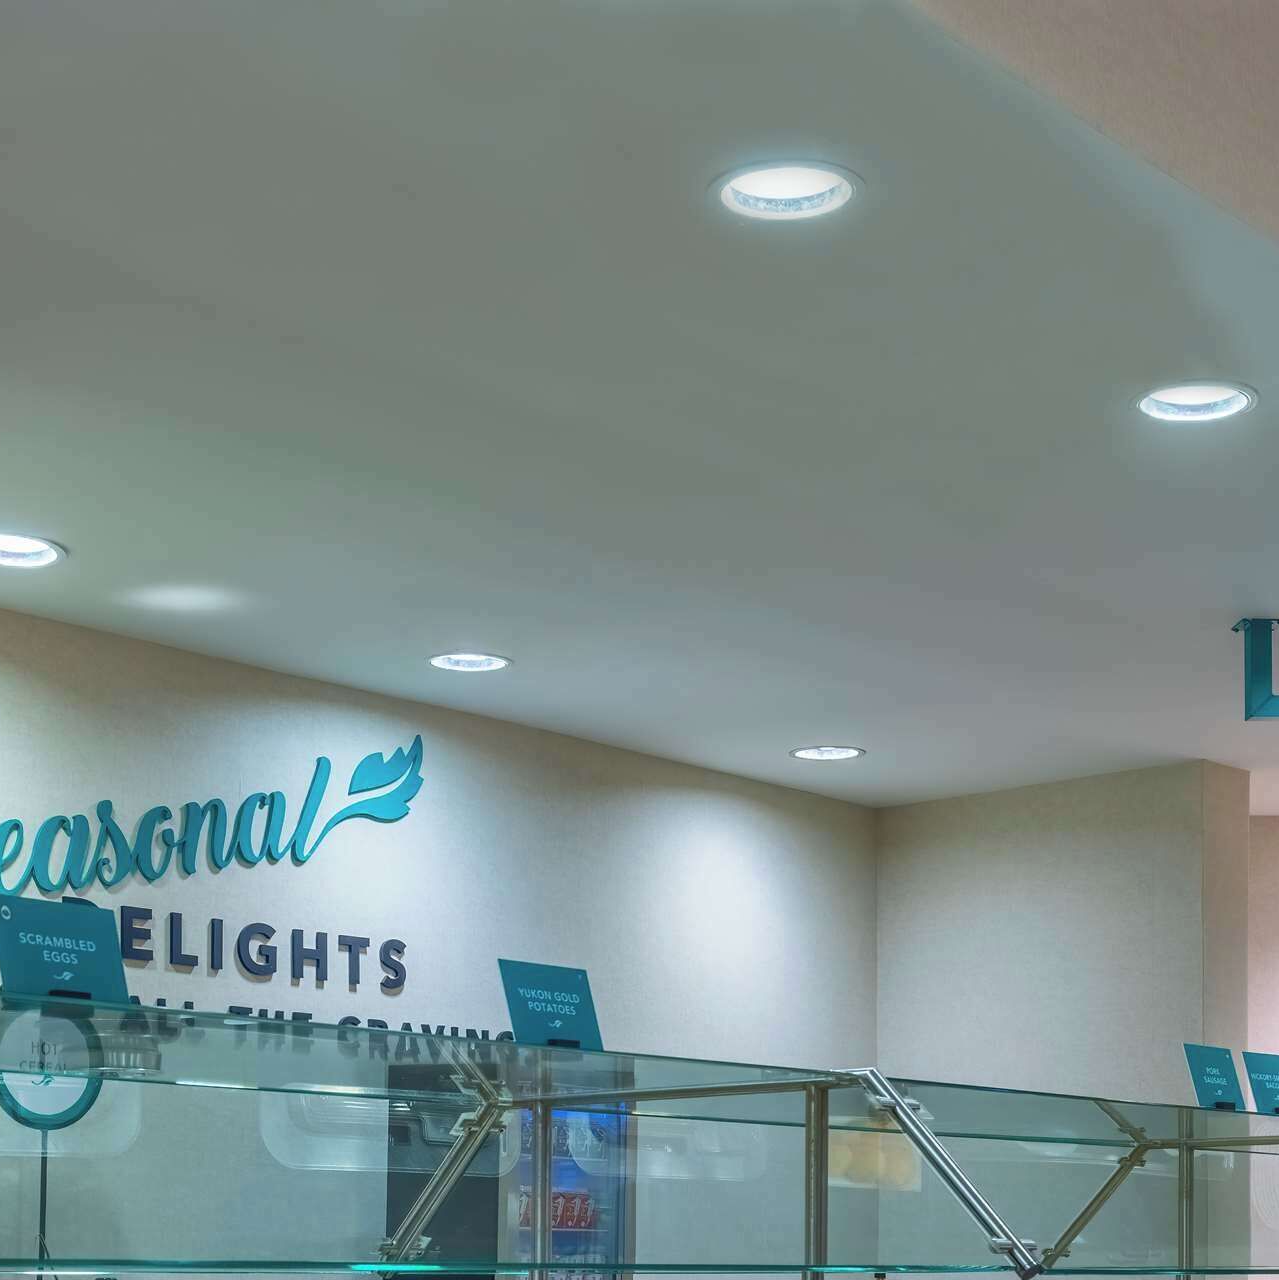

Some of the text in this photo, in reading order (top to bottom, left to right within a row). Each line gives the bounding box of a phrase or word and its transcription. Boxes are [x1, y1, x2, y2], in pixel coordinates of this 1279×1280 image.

[19, 932, 96, 952] SCRAMBLED
[62, 896, 407, 989] ELIGHTS
[43, 950, 79, 965] EGGS
[518, 987, 580, 1003] YUKON GOLD
[528, 1001, 576, 1015] POTATOES
